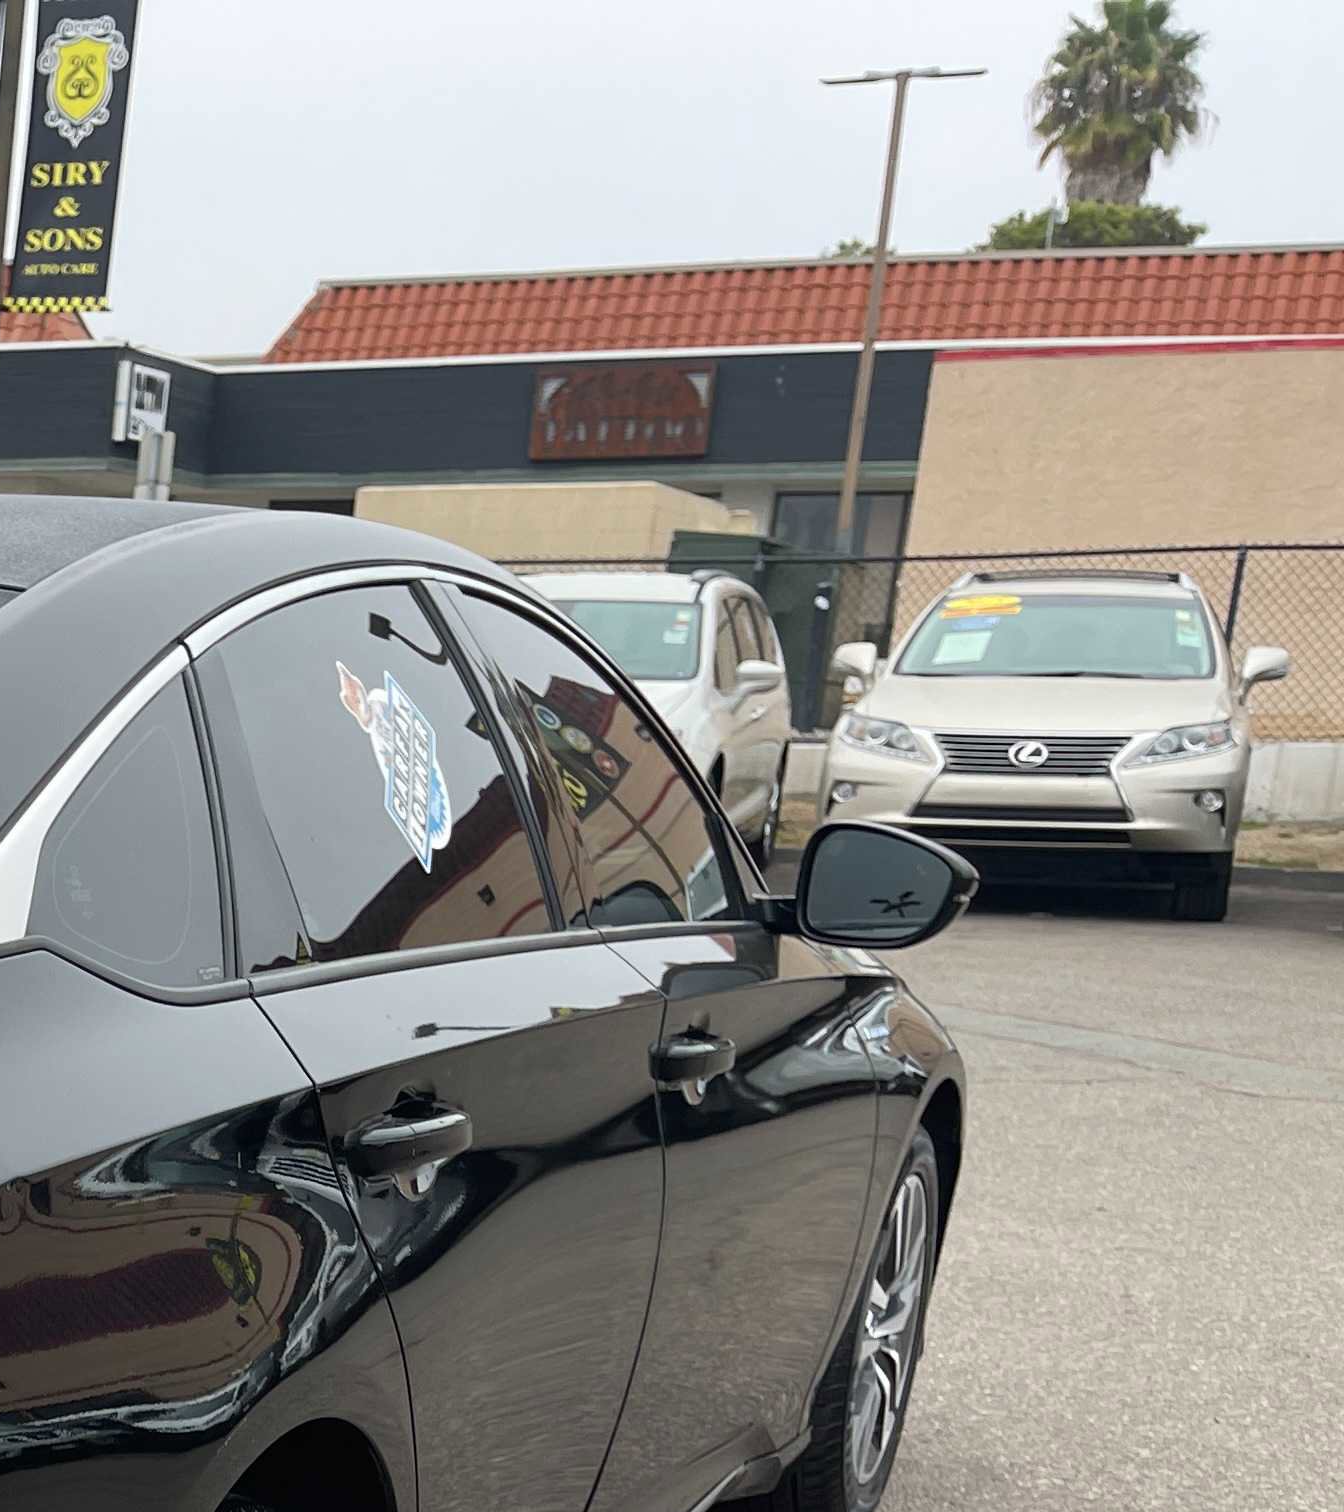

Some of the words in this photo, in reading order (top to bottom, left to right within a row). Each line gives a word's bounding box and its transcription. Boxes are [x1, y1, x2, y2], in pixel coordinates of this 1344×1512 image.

[31, 160, 111, 187] SIRY
[53, 197, 80, 216] &
[24, 227, 104, 252] SONS
